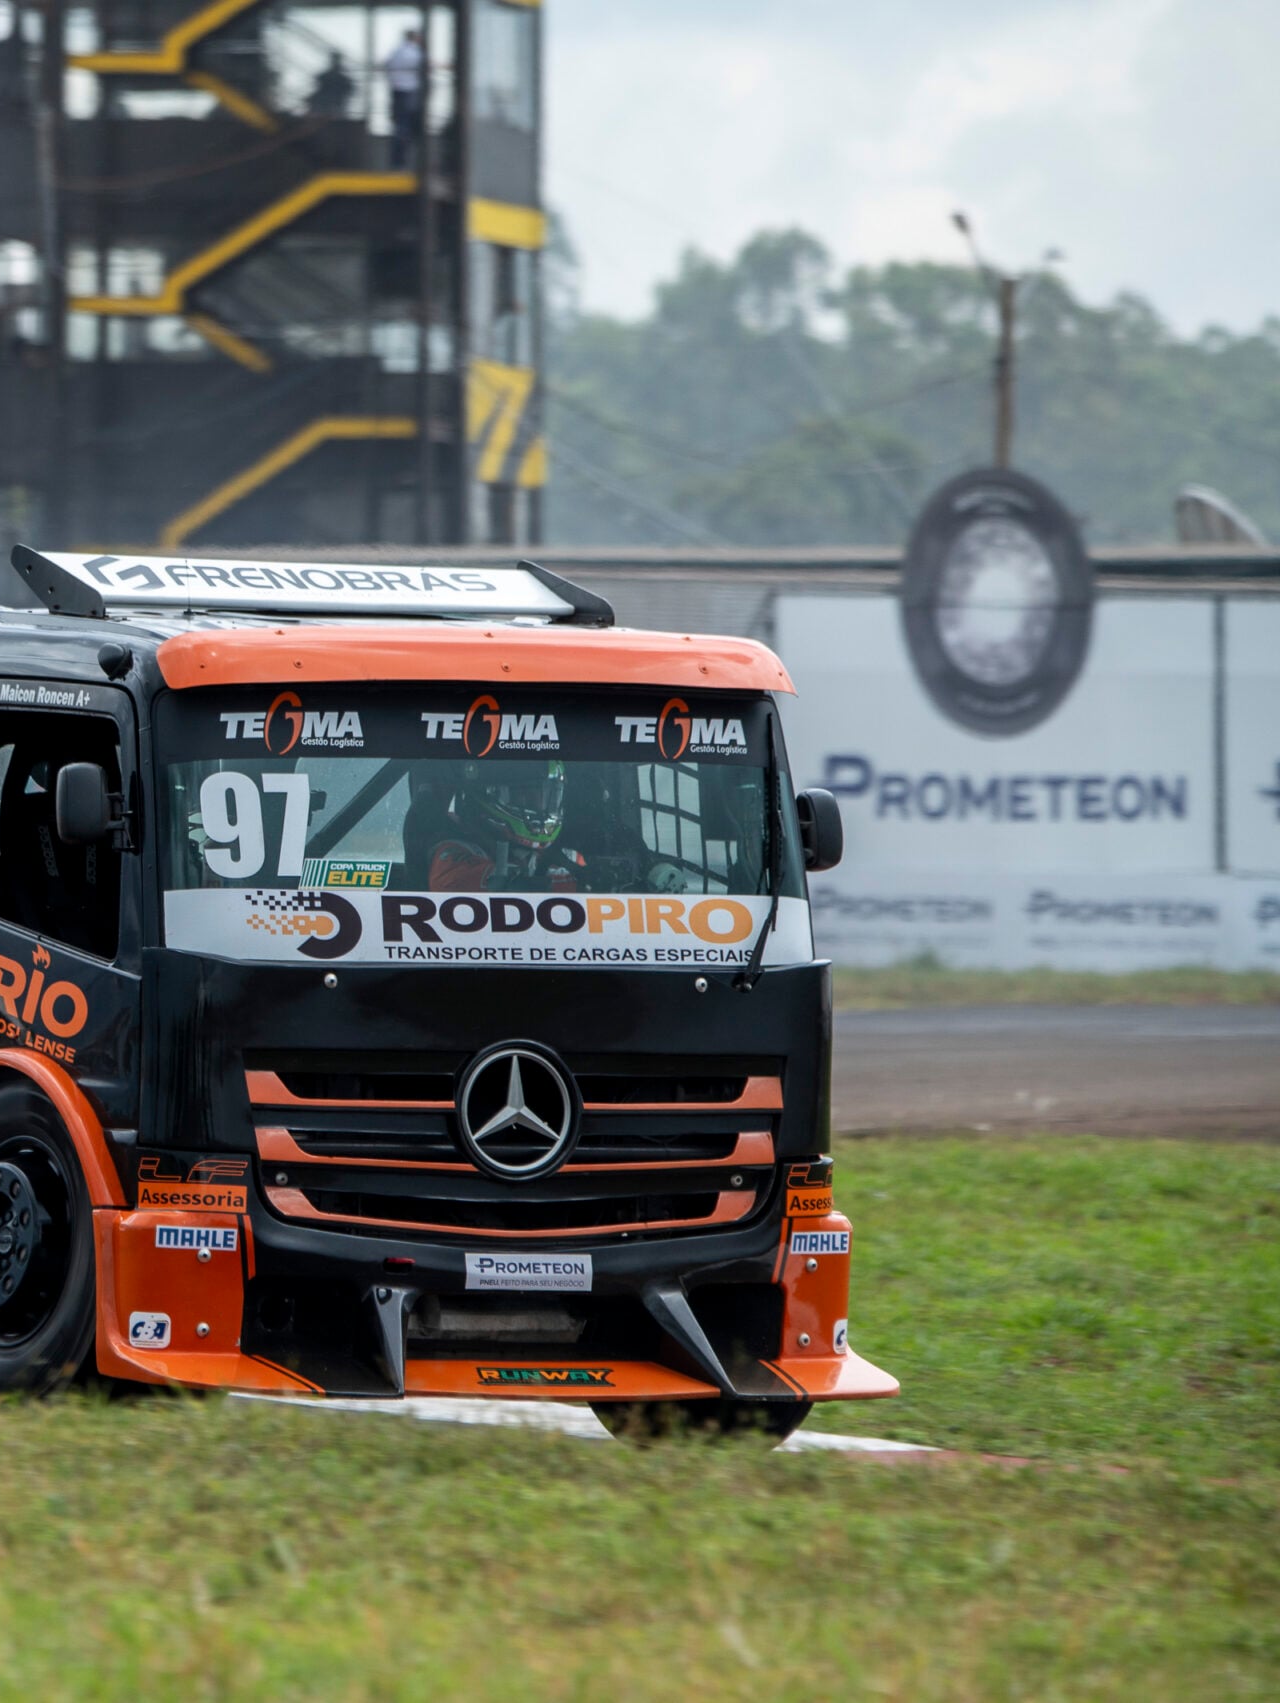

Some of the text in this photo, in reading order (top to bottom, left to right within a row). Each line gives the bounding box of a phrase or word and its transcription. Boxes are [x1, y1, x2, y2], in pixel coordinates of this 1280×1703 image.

[164, 563, 497, 593] FRENOBRAS
[0, 683, 90, 707] Maicon Roncen A+
[219, 691, 364, 756] TEGMA
[421, 694, 559, 758] TEGMA
[614, 697, 747, 760] TEGMA
[301, 737, 365, 749] Gestão Logística
[498, 740, 560, 752] Gestão Logística
[690, 744, 748, 757] Gestão Logística
[816, 753, 1188, 824] PROMETEON
[199, 770, 311, 879] 97
[330, 862, 387, 872] COPA TRUCK
[326, 870, 385, 886] ELITE
[380, 894, 754, 945] RODOPIRO
[383, 945, 755, 963] TRANSPORTE DE CARGAS ESPECIAIS
[140, 1188, 245, 1208] Assessoria
[158, 1227, 235, 1249] MAHLE
[792, 1234, 849, 1252] MAHLE
[475, 1257, 585, 1274] PROMETEON
[479, 1369, 605, 1381] RUNWAY
